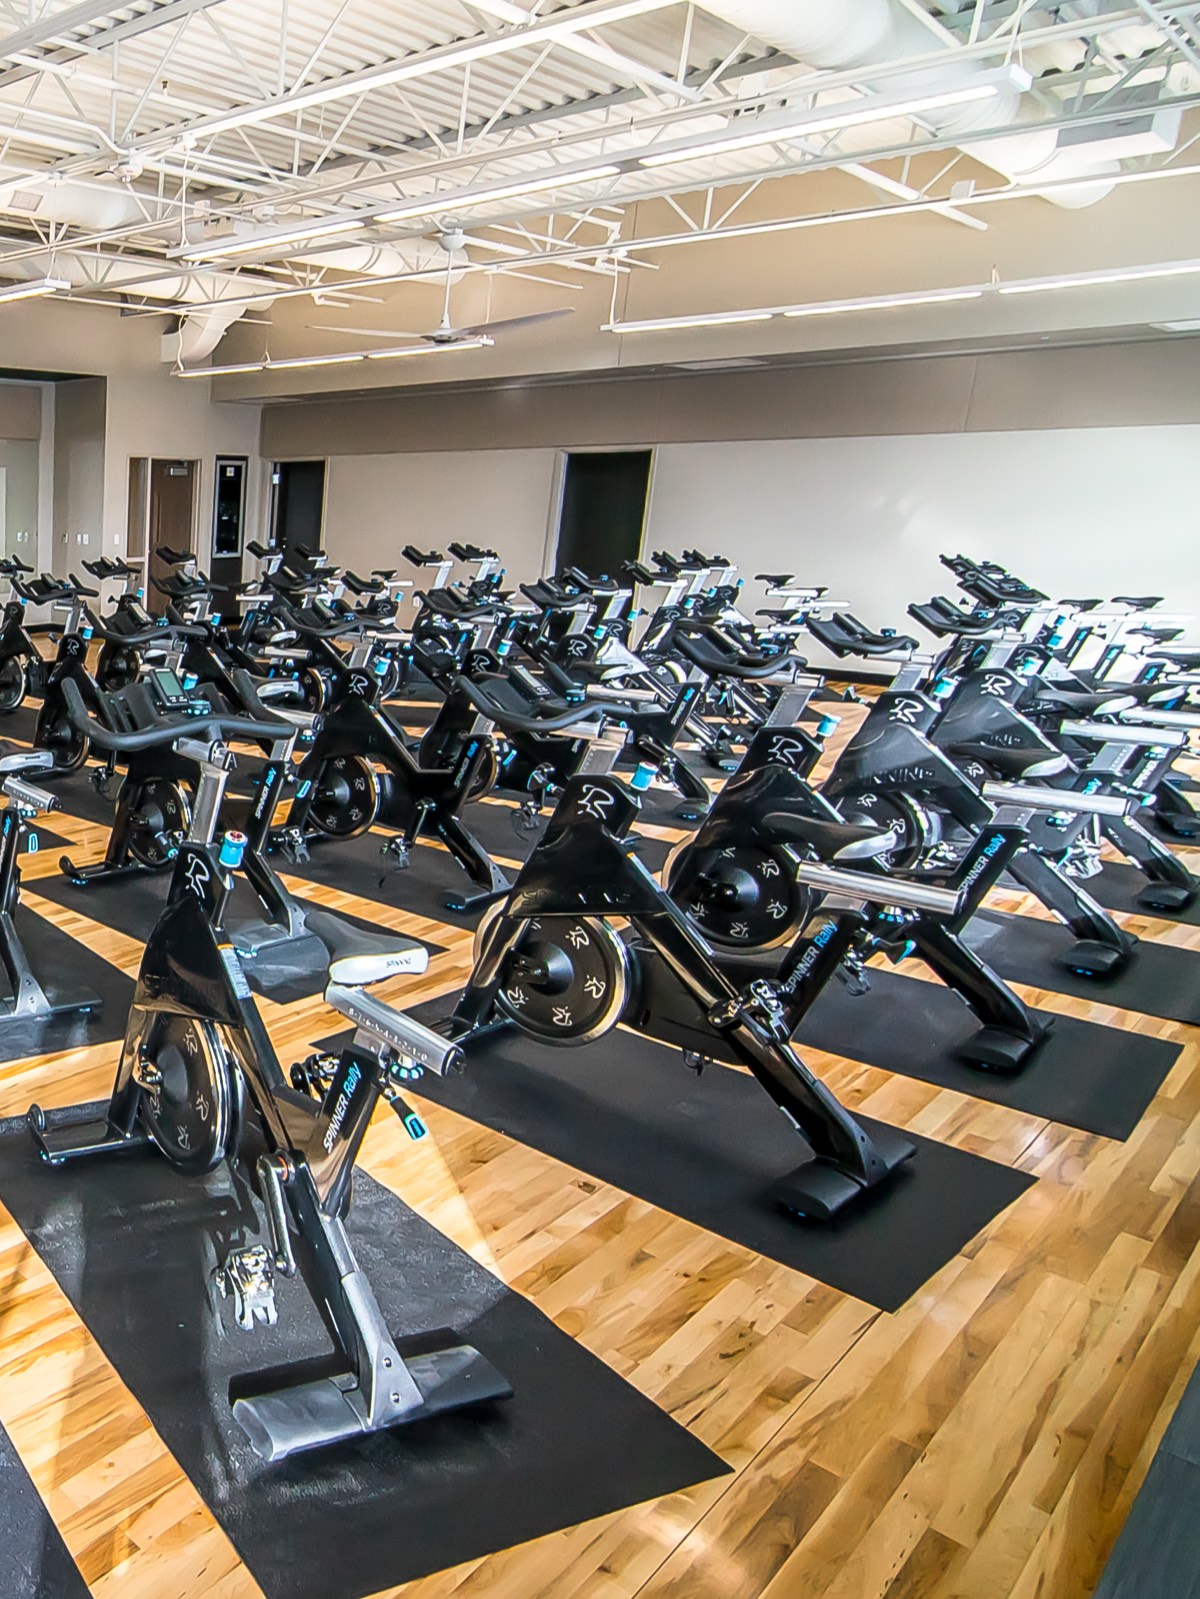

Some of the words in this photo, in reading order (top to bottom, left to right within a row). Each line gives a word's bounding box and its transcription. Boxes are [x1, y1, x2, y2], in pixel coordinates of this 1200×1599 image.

[983, 833, 1007, 858] Rally
[786, 945, 820, 994] SPINNER
[813, 919, 838, 948] Rally
[323, 1103, 350, 1154] SPINNER
[343, 1061, 362, 1098] Rally
